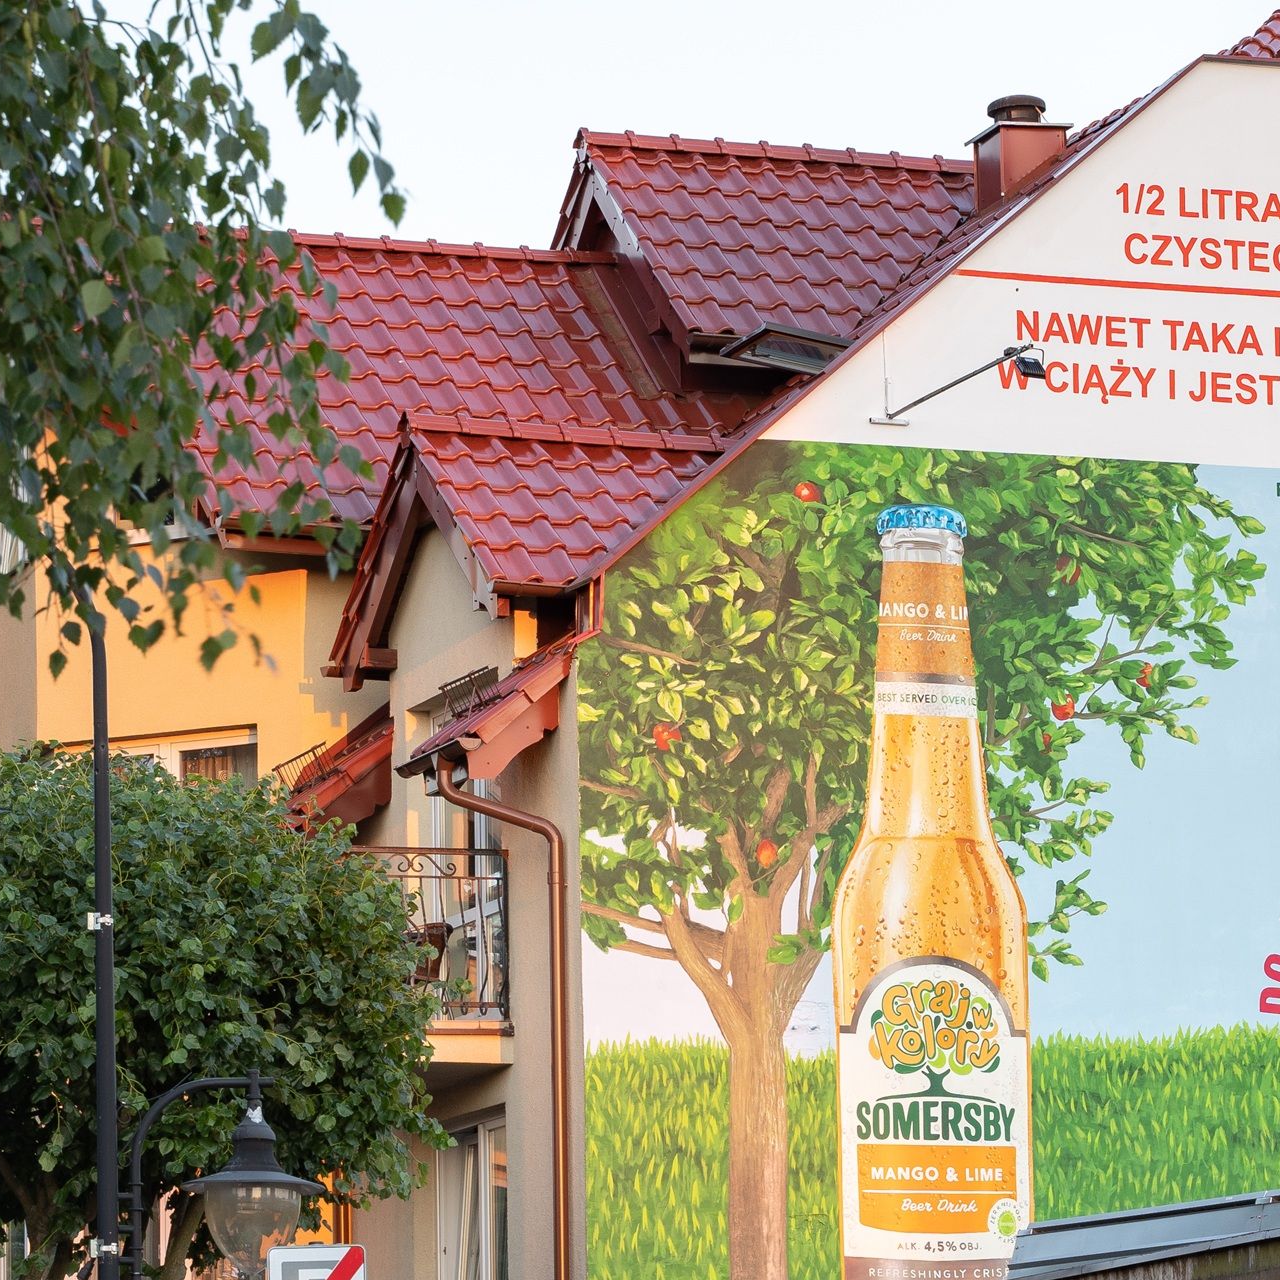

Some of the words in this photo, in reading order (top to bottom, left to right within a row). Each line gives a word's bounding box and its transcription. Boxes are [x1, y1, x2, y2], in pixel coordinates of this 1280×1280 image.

[1116, 183, 1165, 216] 1/2
[1017, 310, 1151, 348] NAWET
[1163, 320, 1263, 356] TAKA
[997, 358, 1032, 390] W
[1045, 359, 1156, 405] CIĄŻY
[1168, 369, 1176, 400] I
[1190, 371, 1280, 405] JEST
[877, 692, 897, 702] BEST
[899, 693, 938, 704] SERVED
[941, 694, 967, 705] OVER
[856, 1100, 1016, 1142] SOMERSBY
[870, 1166, 940, 1182] MANGO
[945, 1166, 960, 1183] &
[965, 1167, 1004, 1182] LIME
[900, 1199, 933, 1213] Beer
[936, 1198, 979, 1214] Drink
[924, 1240, 957, 1253] 4,5%
[868, 1267, 967, 1279] REFRESHINGLY
